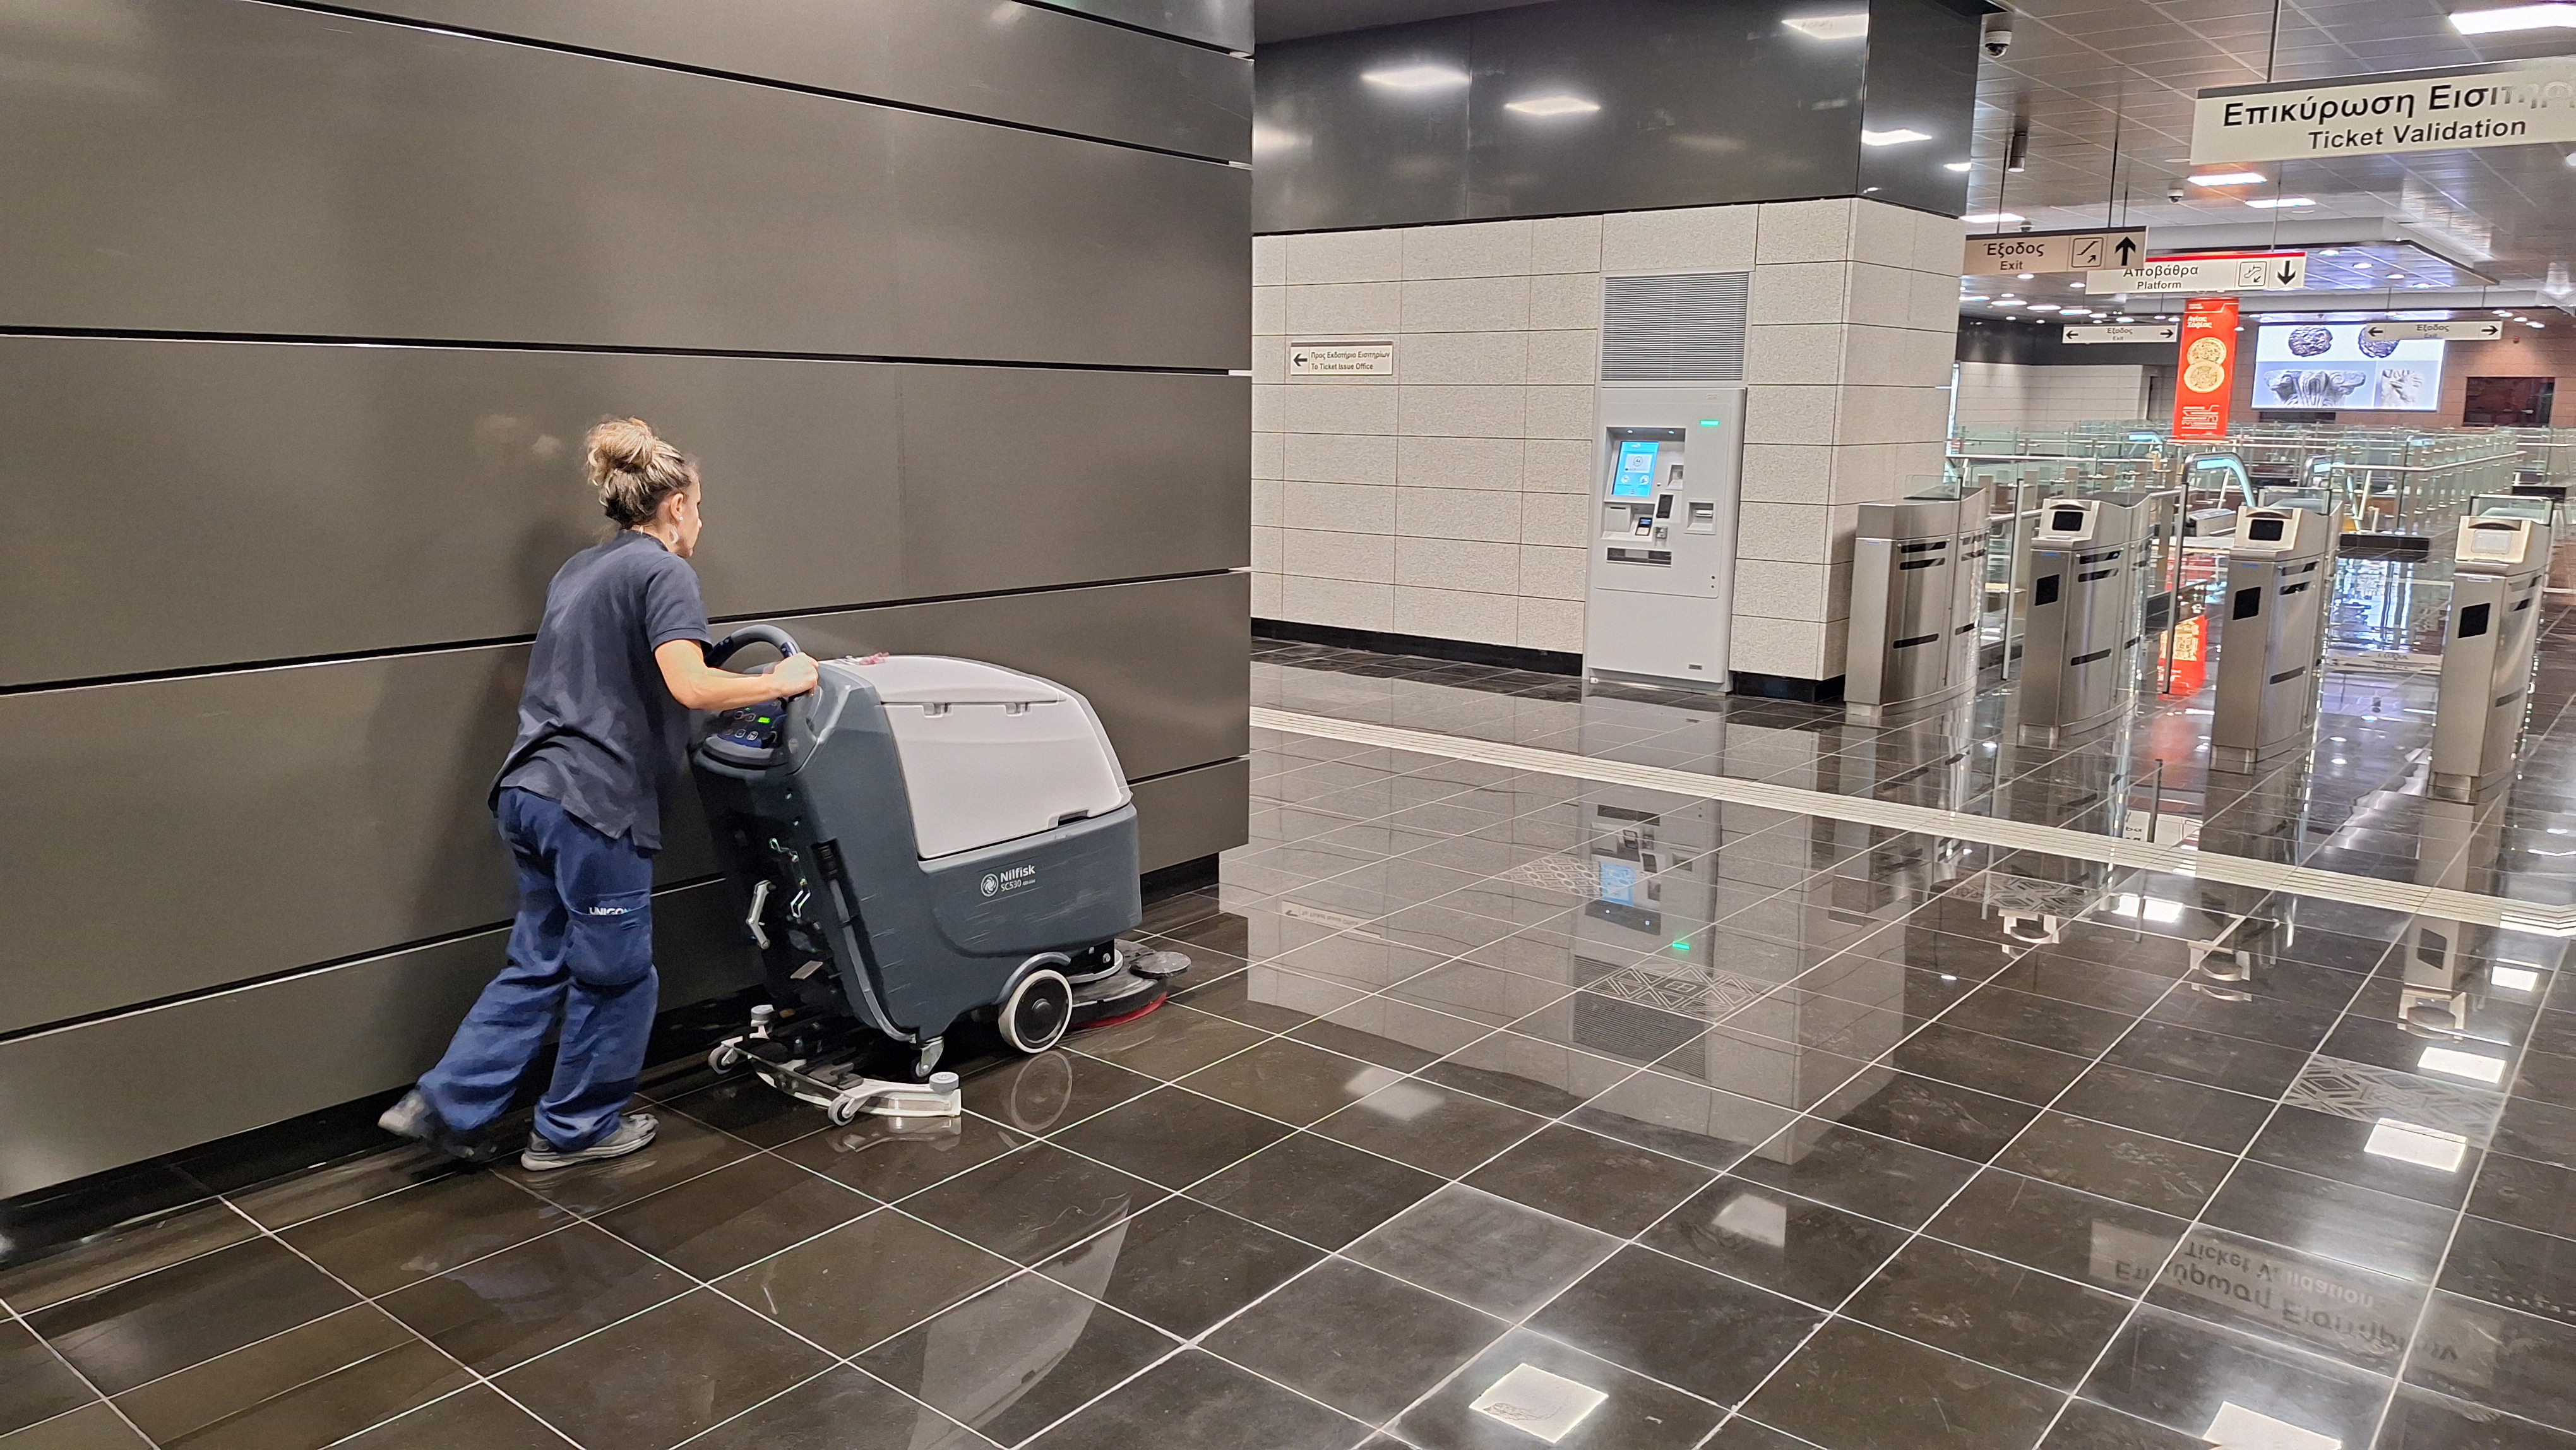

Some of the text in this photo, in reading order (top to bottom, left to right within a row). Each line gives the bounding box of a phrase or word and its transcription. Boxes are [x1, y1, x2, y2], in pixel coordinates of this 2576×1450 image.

[2223, 92, 2414, 126] Επικύρωση
[2308, 119, 2526, 150] Ticket Validation
[1983, 242, 2045, 258] Έξοδος
[2000, 260, 2023, 270] Exit
[2123, 265, 2198, 279] Αποβάθρα
[2137, 280, 2181, 289] Platform
[1000, 865, 1036, 883] Nilfisk
[1001, 878, 1022, 892] SC530
